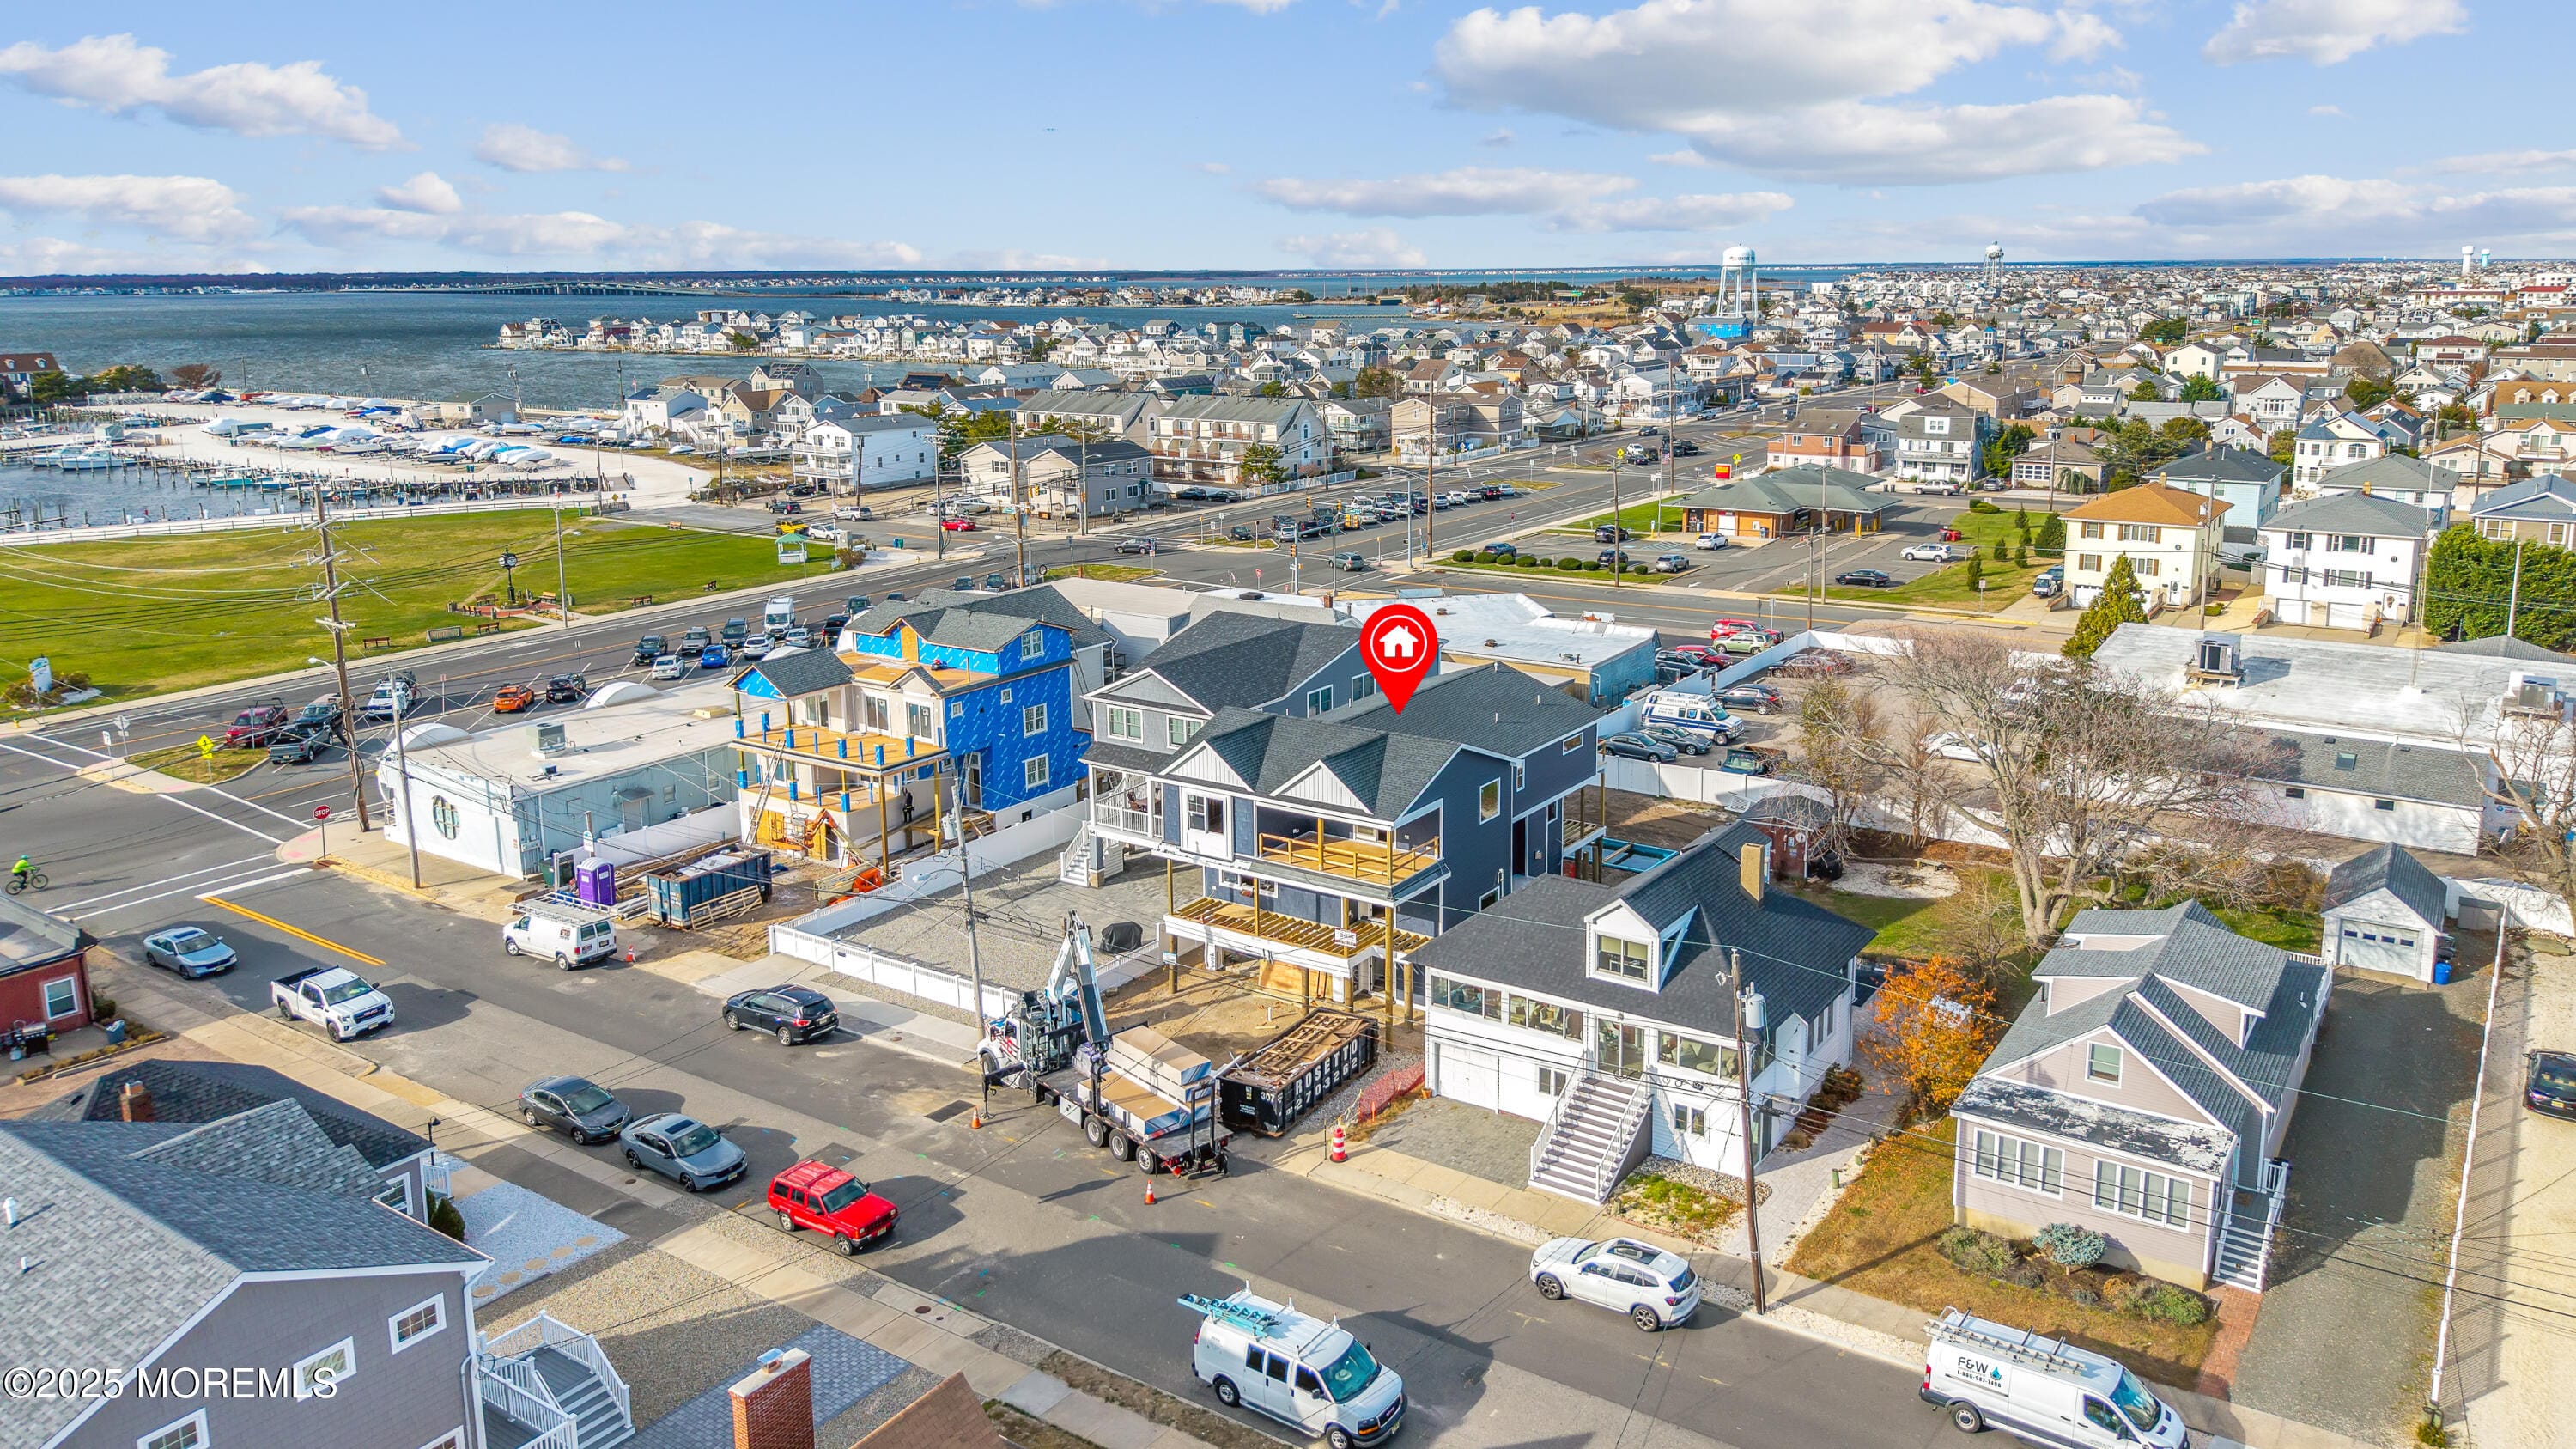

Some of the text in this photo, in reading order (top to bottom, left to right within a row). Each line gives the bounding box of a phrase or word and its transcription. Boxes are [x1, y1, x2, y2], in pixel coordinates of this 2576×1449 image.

[314, 808, 330, 817] STOP
[1295, 1038, 1358, 1096] ROSETTO
[1261, 1091, 1276, 1103] 307
[1958, 1356, 1989, 1374] F&W
